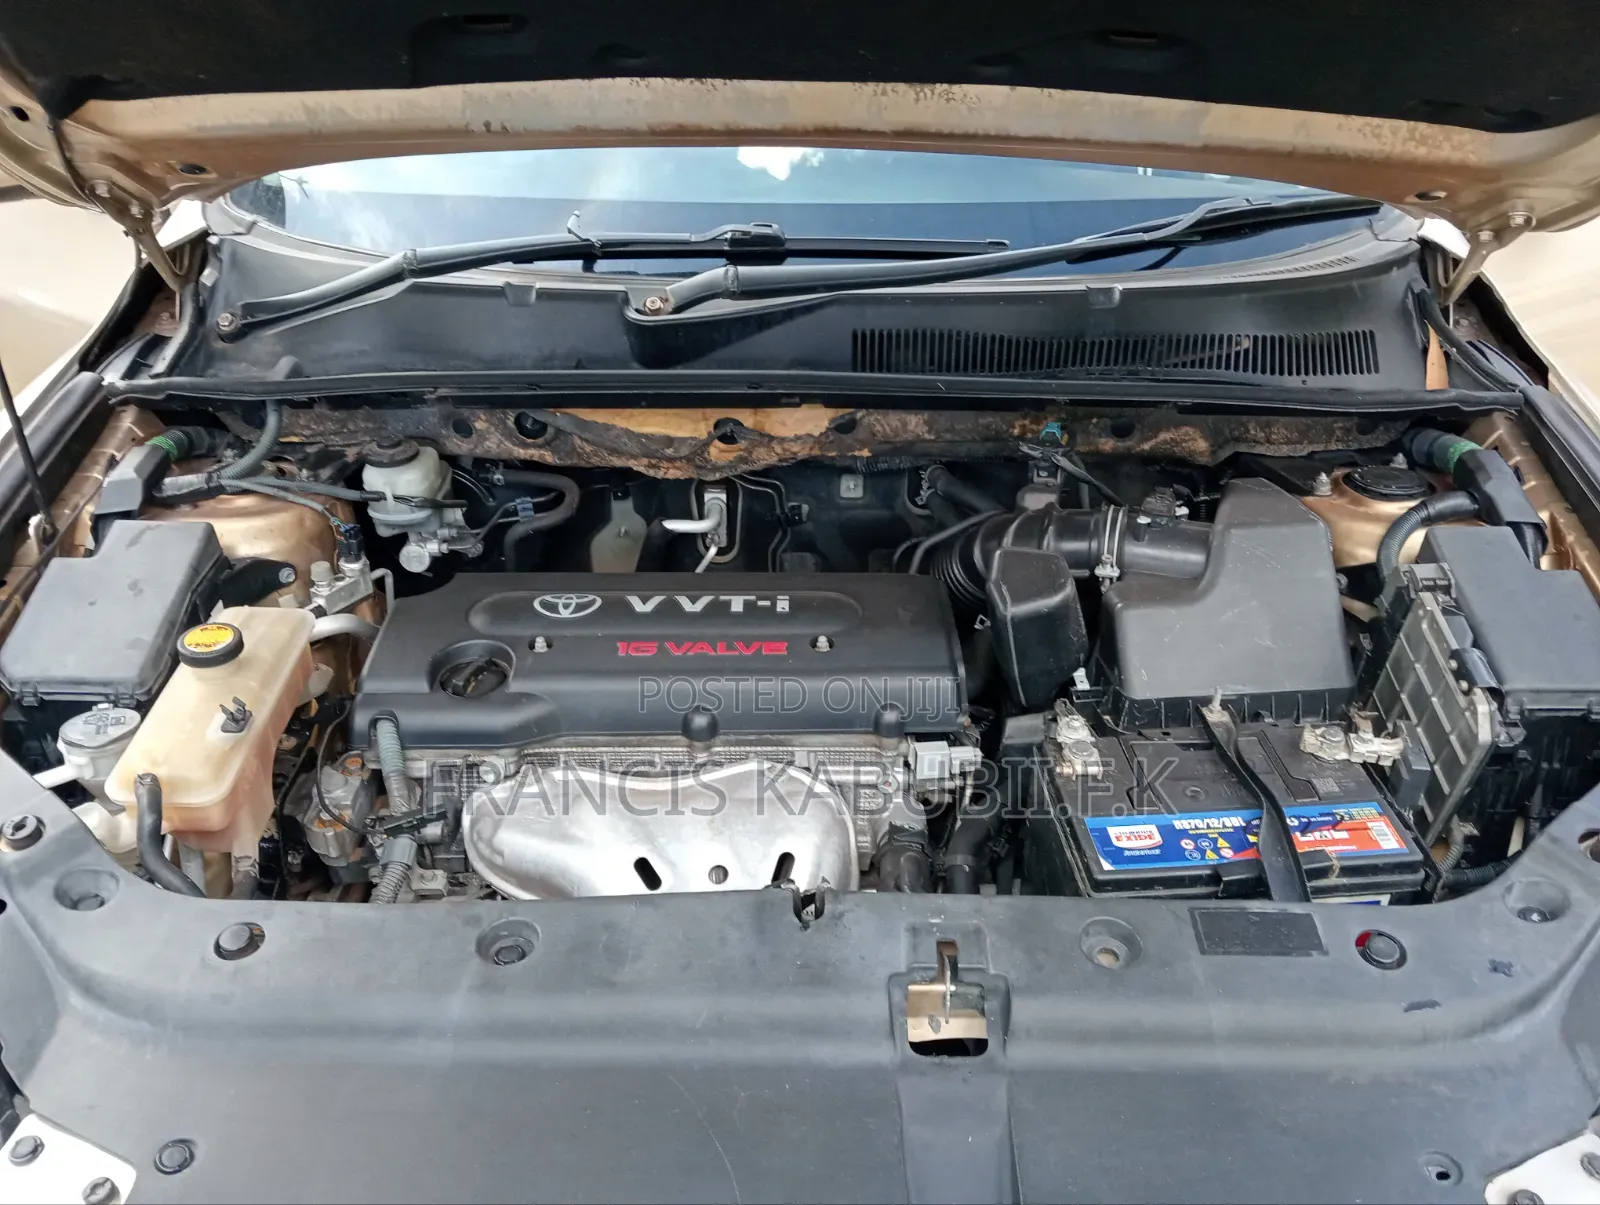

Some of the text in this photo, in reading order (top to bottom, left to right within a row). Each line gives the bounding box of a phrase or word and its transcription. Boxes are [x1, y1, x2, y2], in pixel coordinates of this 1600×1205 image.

[625, 595, 791, 613] VVT-i
[616, 640, 790, 657] 16 VALVE
[1114, 832, 1156, 842] EXIDE
